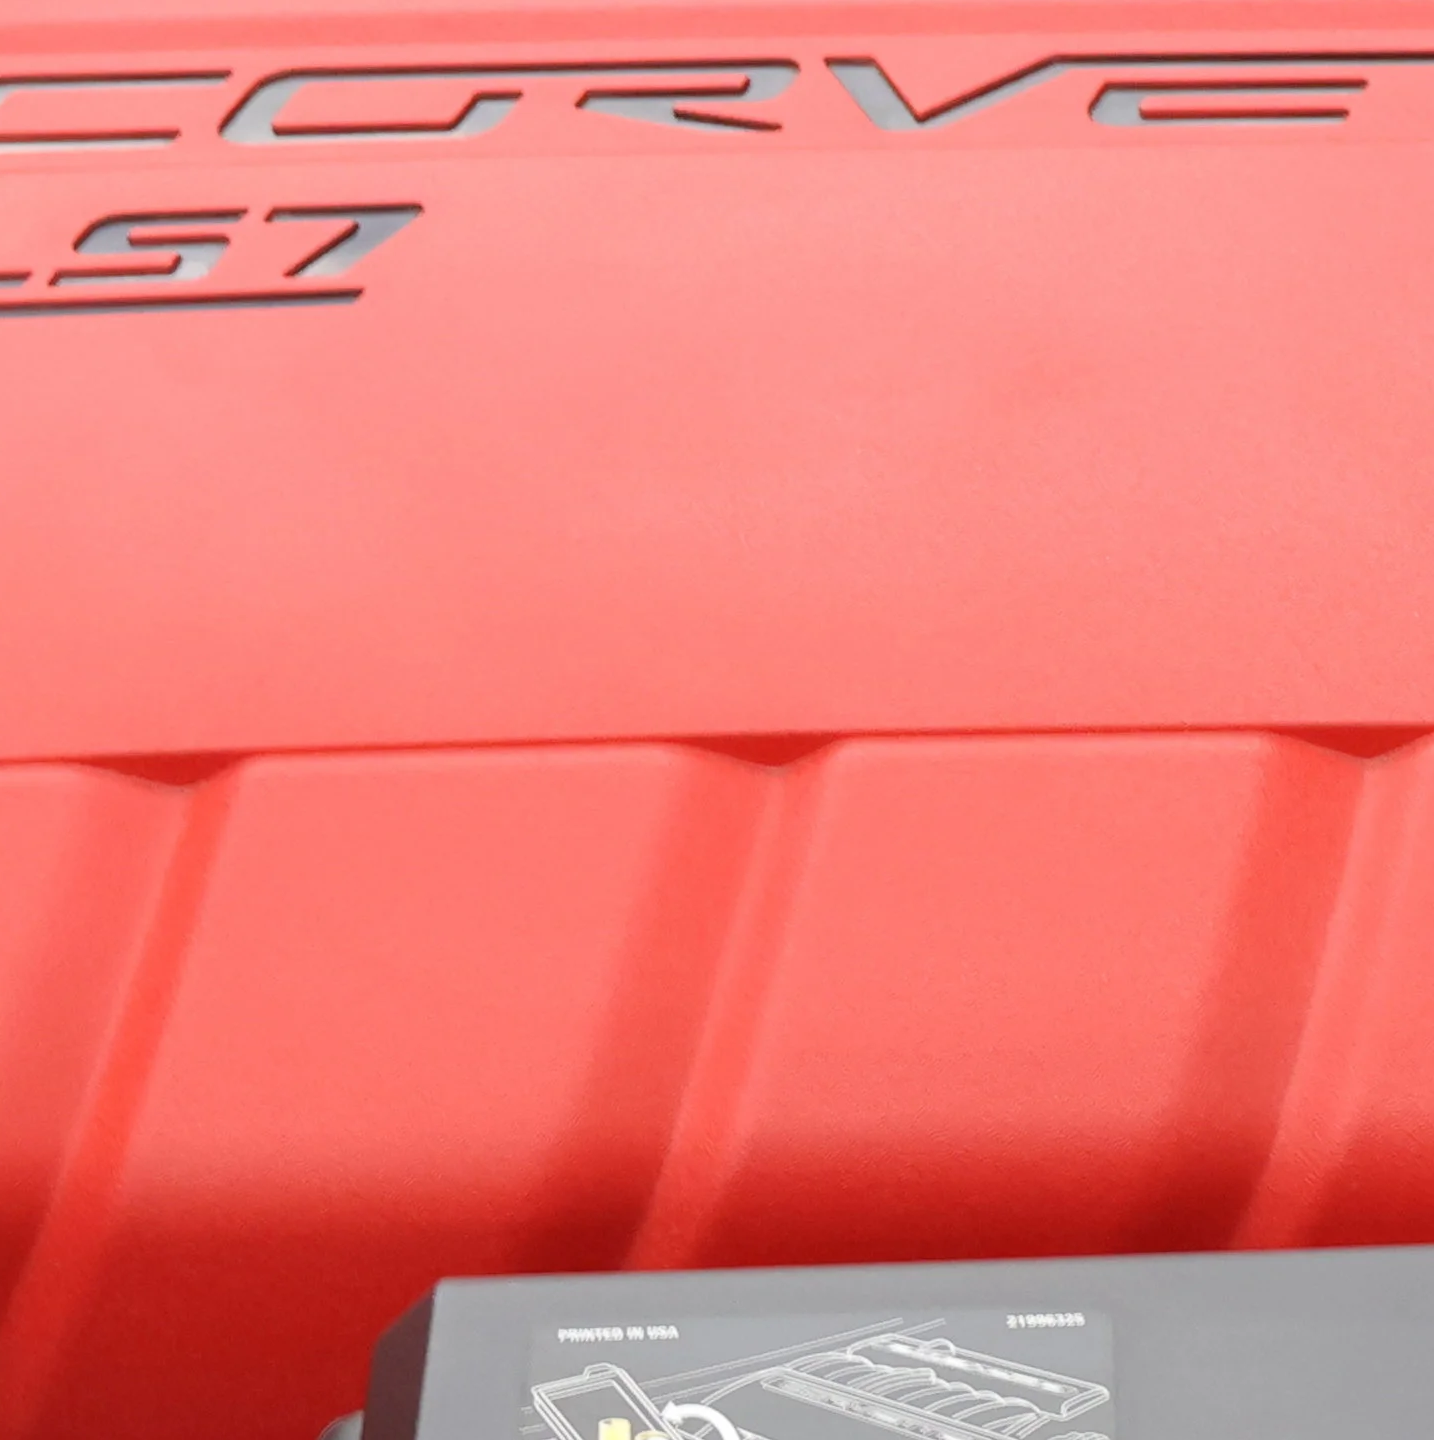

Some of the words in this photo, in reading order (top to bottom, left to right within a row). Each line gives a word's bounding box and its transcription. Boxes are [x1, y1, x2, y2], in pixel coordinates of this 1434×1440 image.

[557, 1327, 624, 1343] PRINTED
[626, 1326, 645, 1341] IN
[646, 1325, 679, 1340] USA
